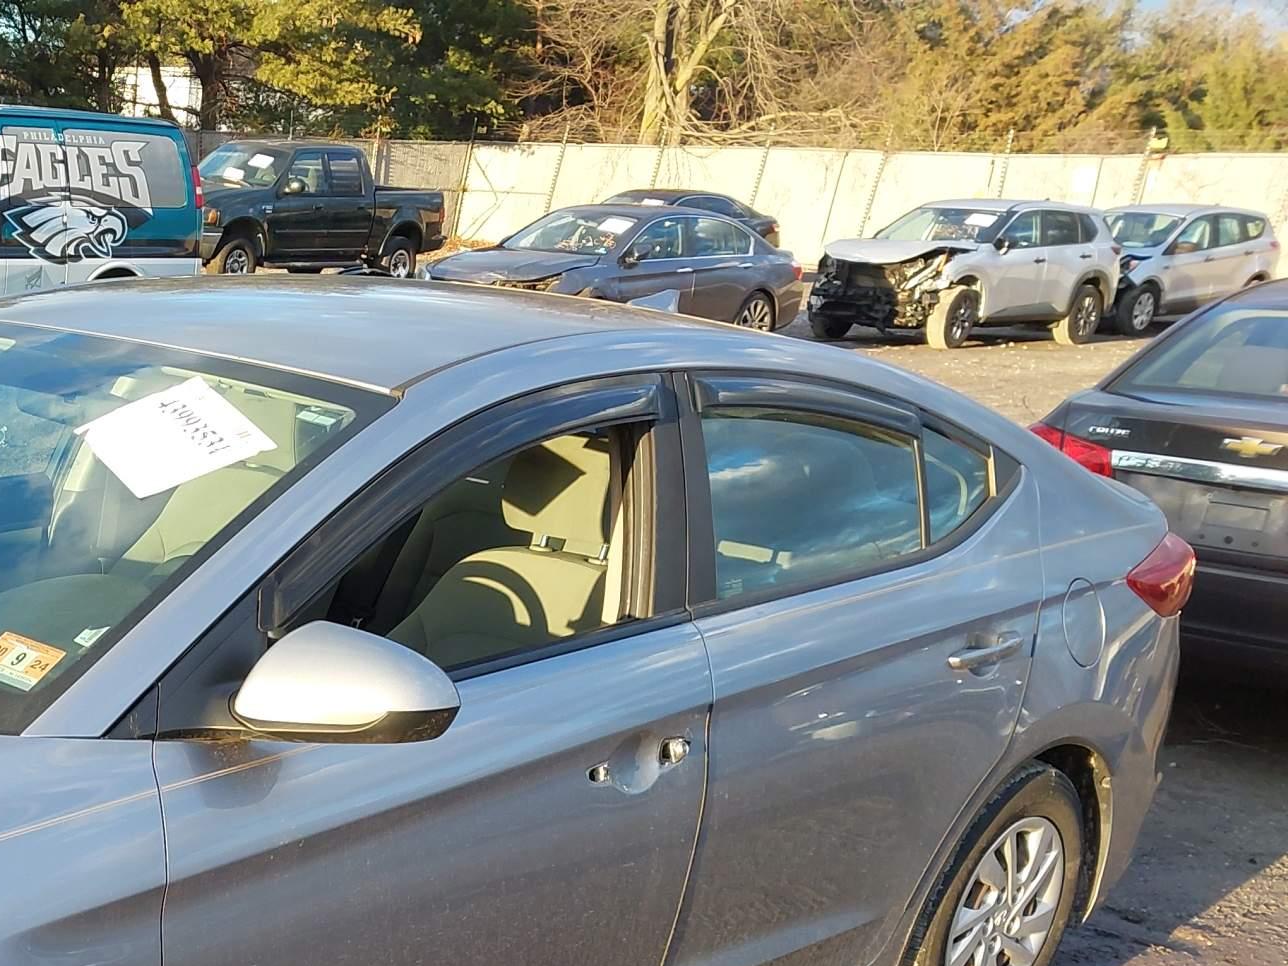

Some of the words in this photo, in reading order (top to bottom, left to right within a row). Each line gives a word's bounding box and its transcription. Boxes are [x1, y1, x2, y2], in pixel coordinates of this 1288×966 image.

[23, 131, 105, 145] PHILADELPHIA
[10, 652, 27, 667] 9
[30, 659, 50, 673] 24
